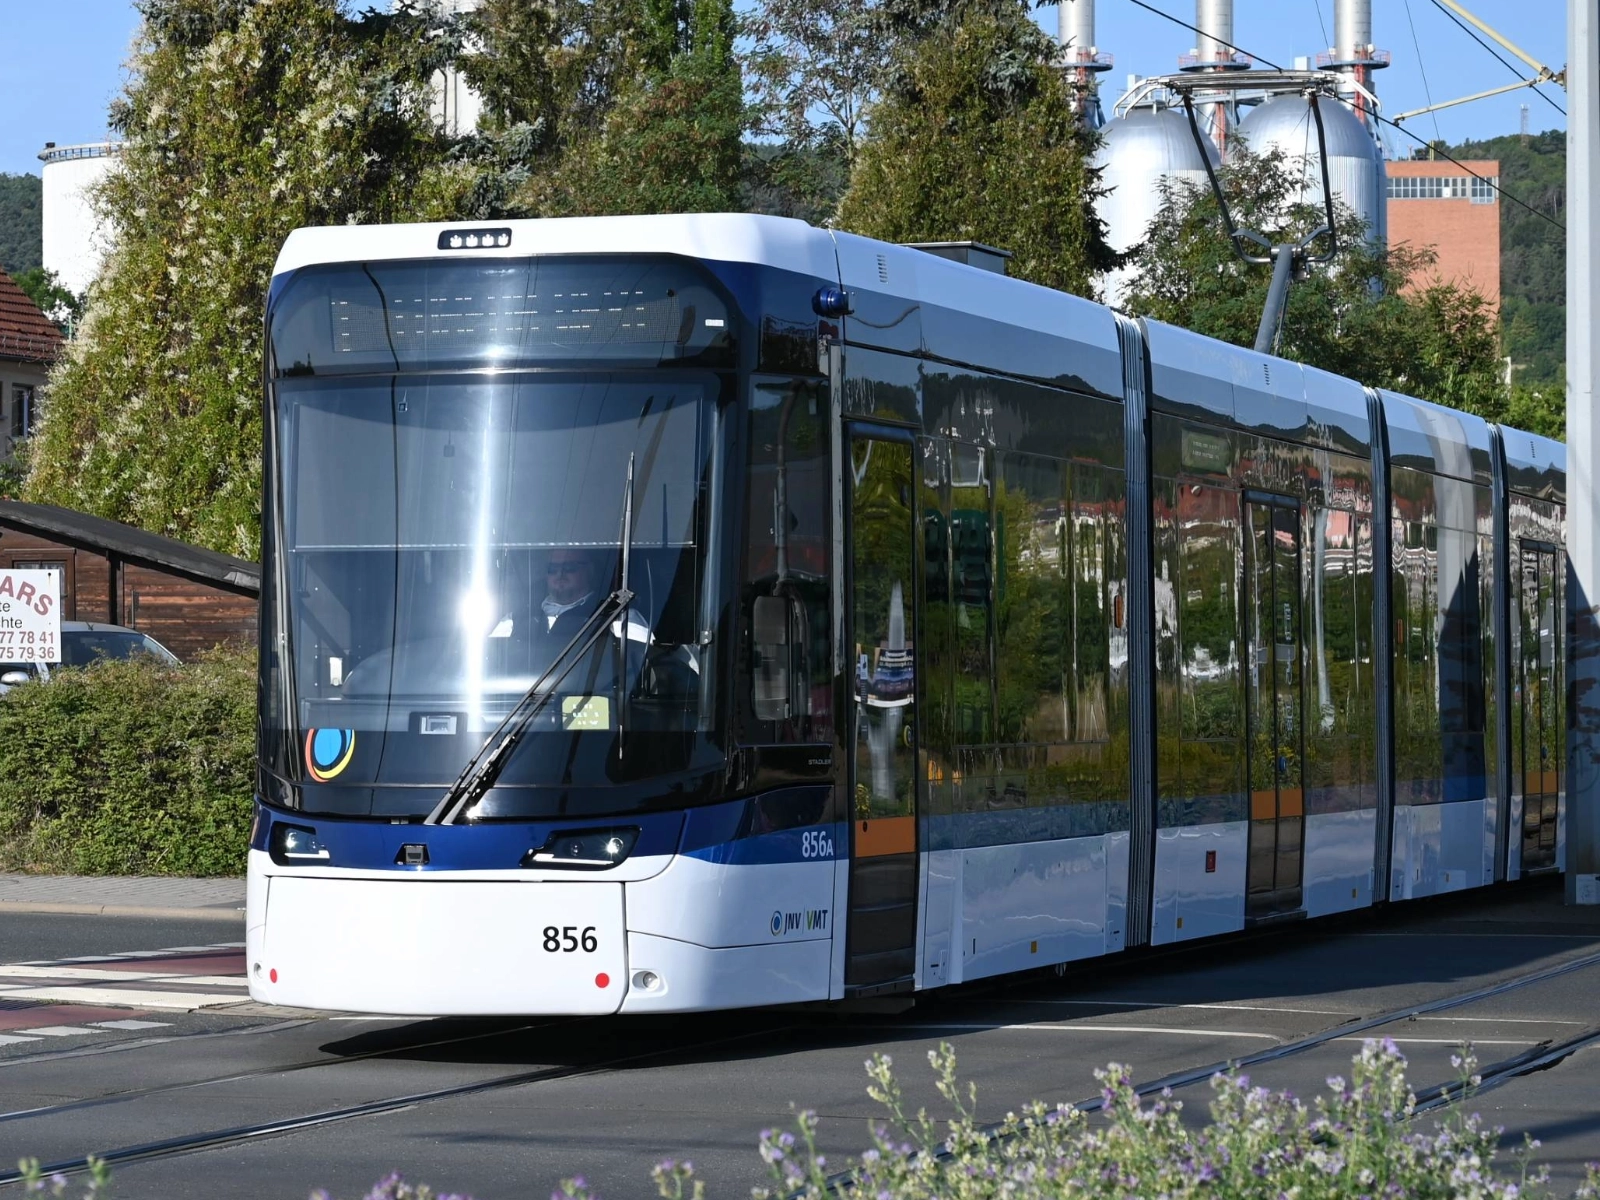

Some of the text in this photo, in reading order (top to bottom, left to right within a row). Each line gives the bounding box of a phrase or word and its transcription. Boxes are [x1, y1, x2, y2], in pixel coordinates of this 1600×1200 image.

[0, 575, 53, 615] ARS
[1, 616, 23, 629] hte
[0, 631, 54, 644] 77 78 41
[0, 647, 55, 659] 75 79 36
[802, 831, 834, 858] 856A
[783, 909, 828, 936] JNV VMT
[542, 925, 598, 953] 856
